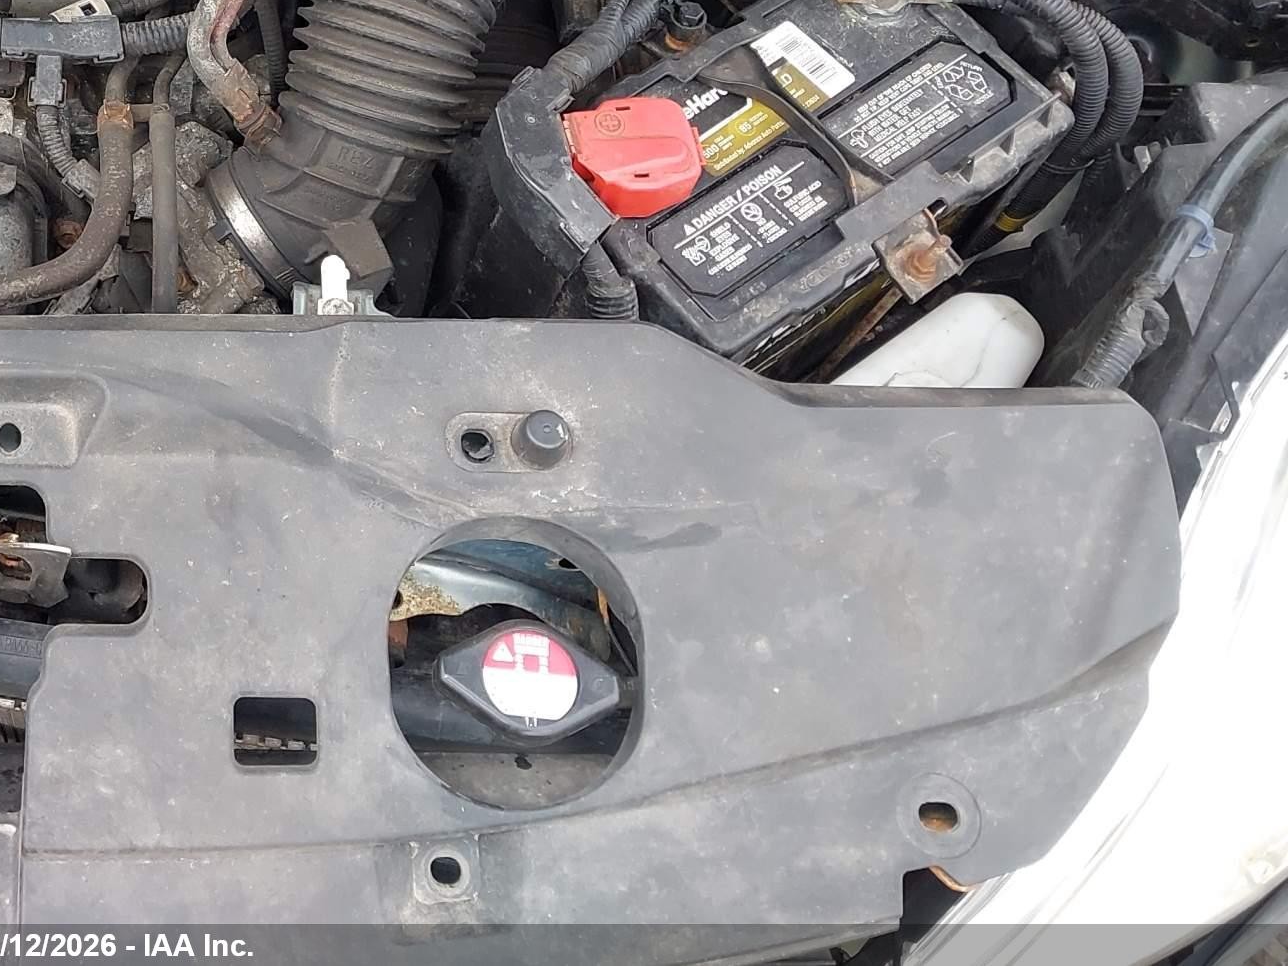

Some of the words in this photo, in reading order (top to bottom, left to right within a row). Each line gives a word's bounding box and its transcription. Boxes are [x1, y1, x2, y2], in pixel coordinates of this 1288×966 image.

[691, 195, 738, 229] DANGER
[733, 189, 742, 201] /
[741, 164, 783, 196] POISON
